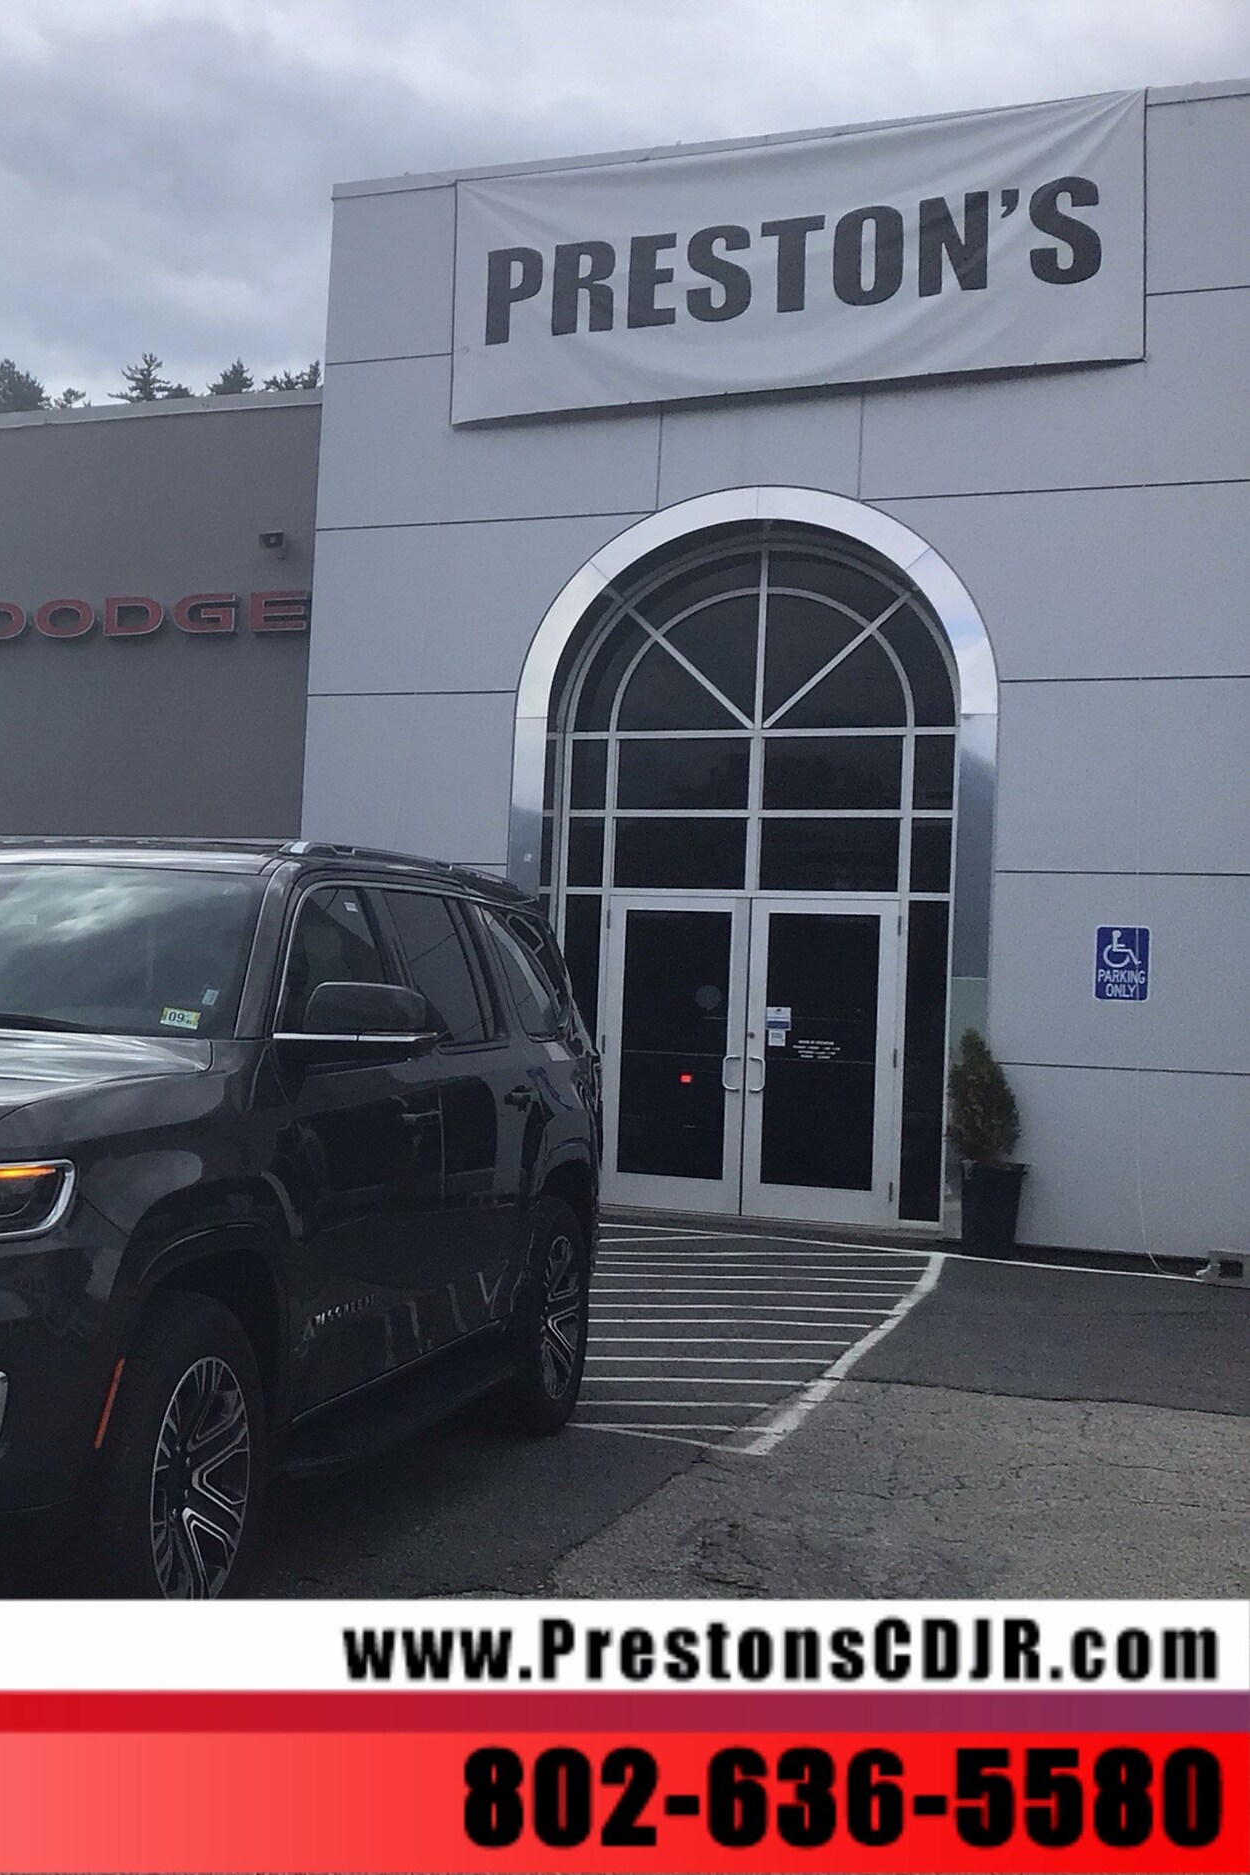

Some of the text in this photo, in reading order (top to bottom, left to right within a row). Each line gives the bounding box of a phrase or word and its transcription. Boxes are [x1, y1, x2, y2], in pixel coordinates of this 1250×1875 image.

[485, 175, 1103, 346] PRESTON'S
[1097, 969, 1146, 984] PARKING
[1105, 983, 1136, 997] ONLY
[168, 1011, 185, 1022] 09
